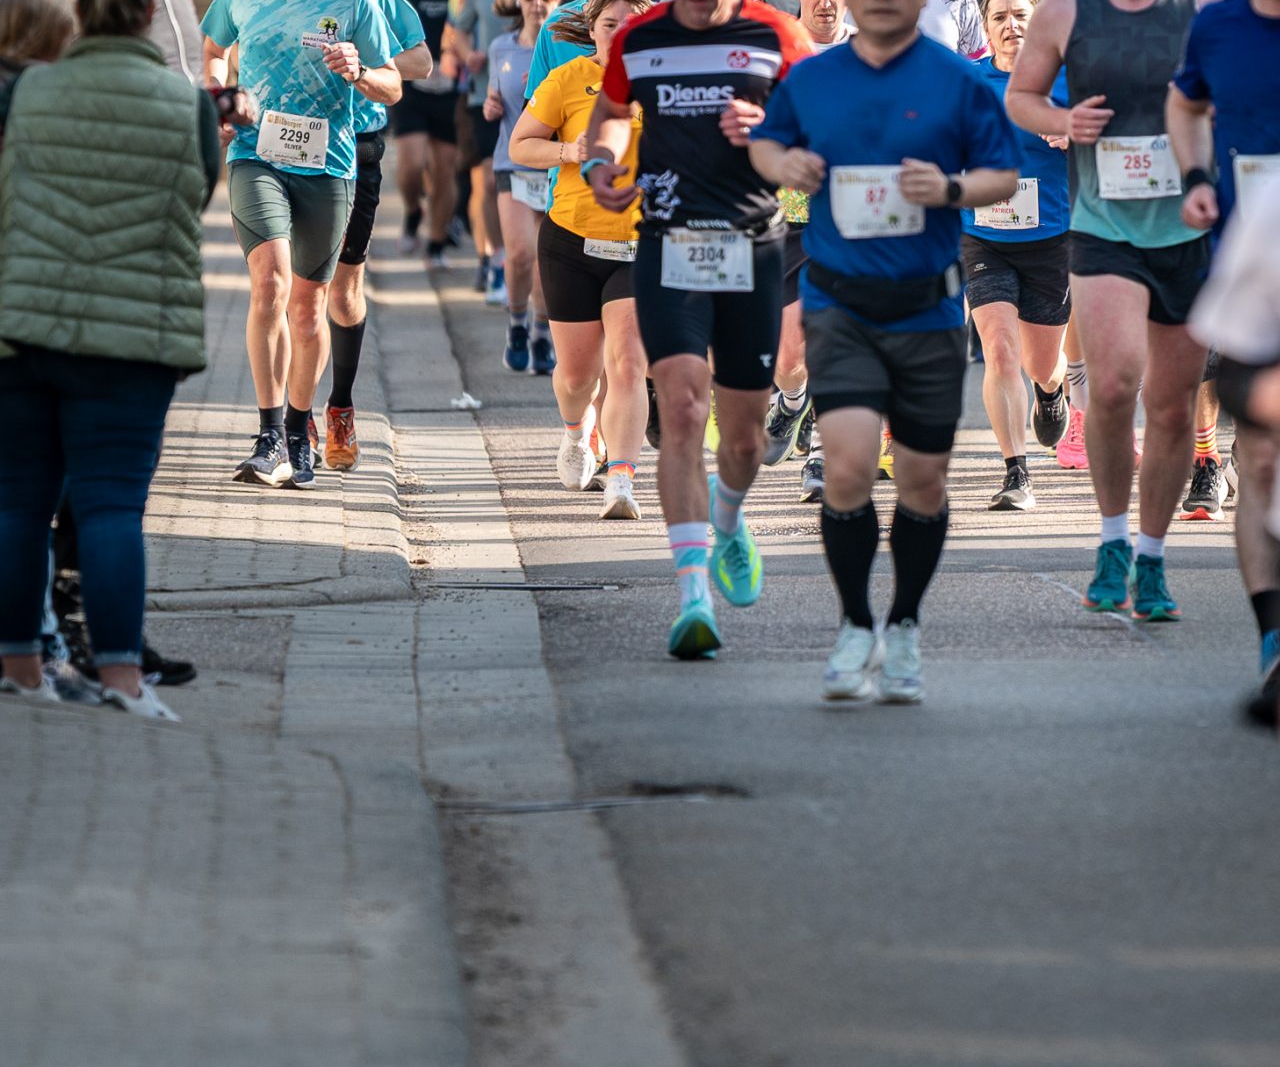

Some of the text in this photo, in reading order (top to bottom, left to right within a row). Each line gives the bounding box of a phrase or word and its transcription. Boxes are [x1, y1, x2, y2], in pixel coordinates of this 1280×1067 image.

[656, 83, 735, 108] Dienes
[279, 128, 310, 144] 2299
[1124, 154, 1152, 170] 285
[865, 187, 887, 206] 87
[688, 246, 726, 262] 2304
